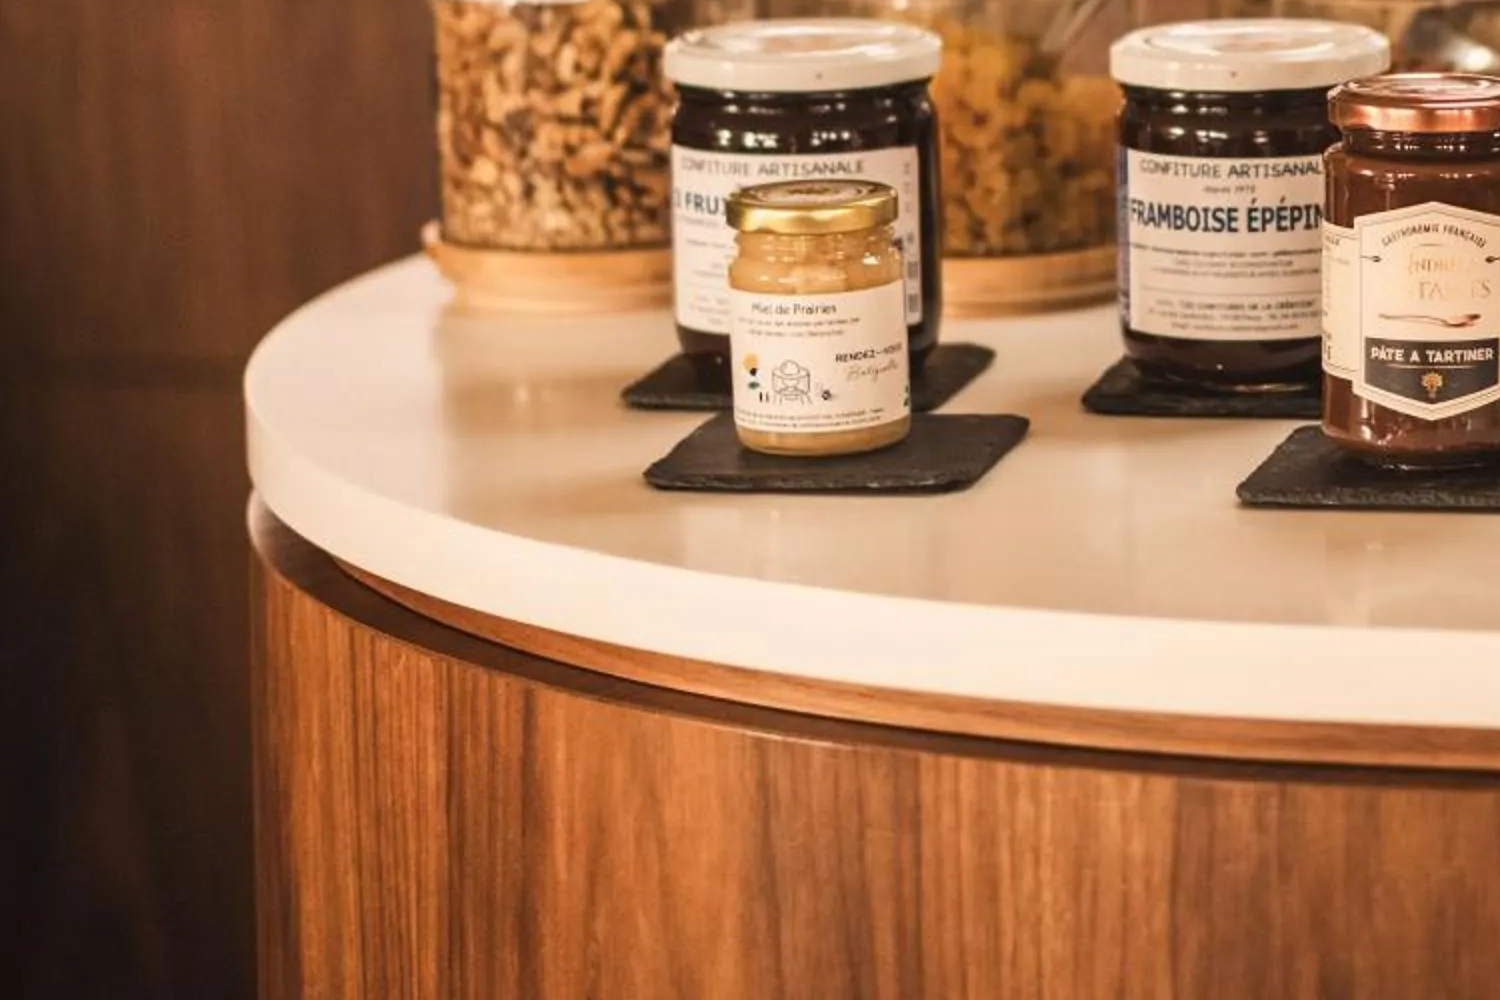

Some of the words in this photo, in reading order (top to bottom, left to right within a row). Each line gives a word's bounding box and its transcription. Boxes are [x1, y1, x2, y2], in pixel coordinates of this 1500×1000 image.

[757, 160, 866, 177] ARTISANALE
[1140, 160, 1222, 178] CONFITURE
[1131, 199, 1240, 233] FRAMBOISE
[1371, 345, 1404, 361] PÂTE
[1426, 347, 1494, 363] TARTINER
